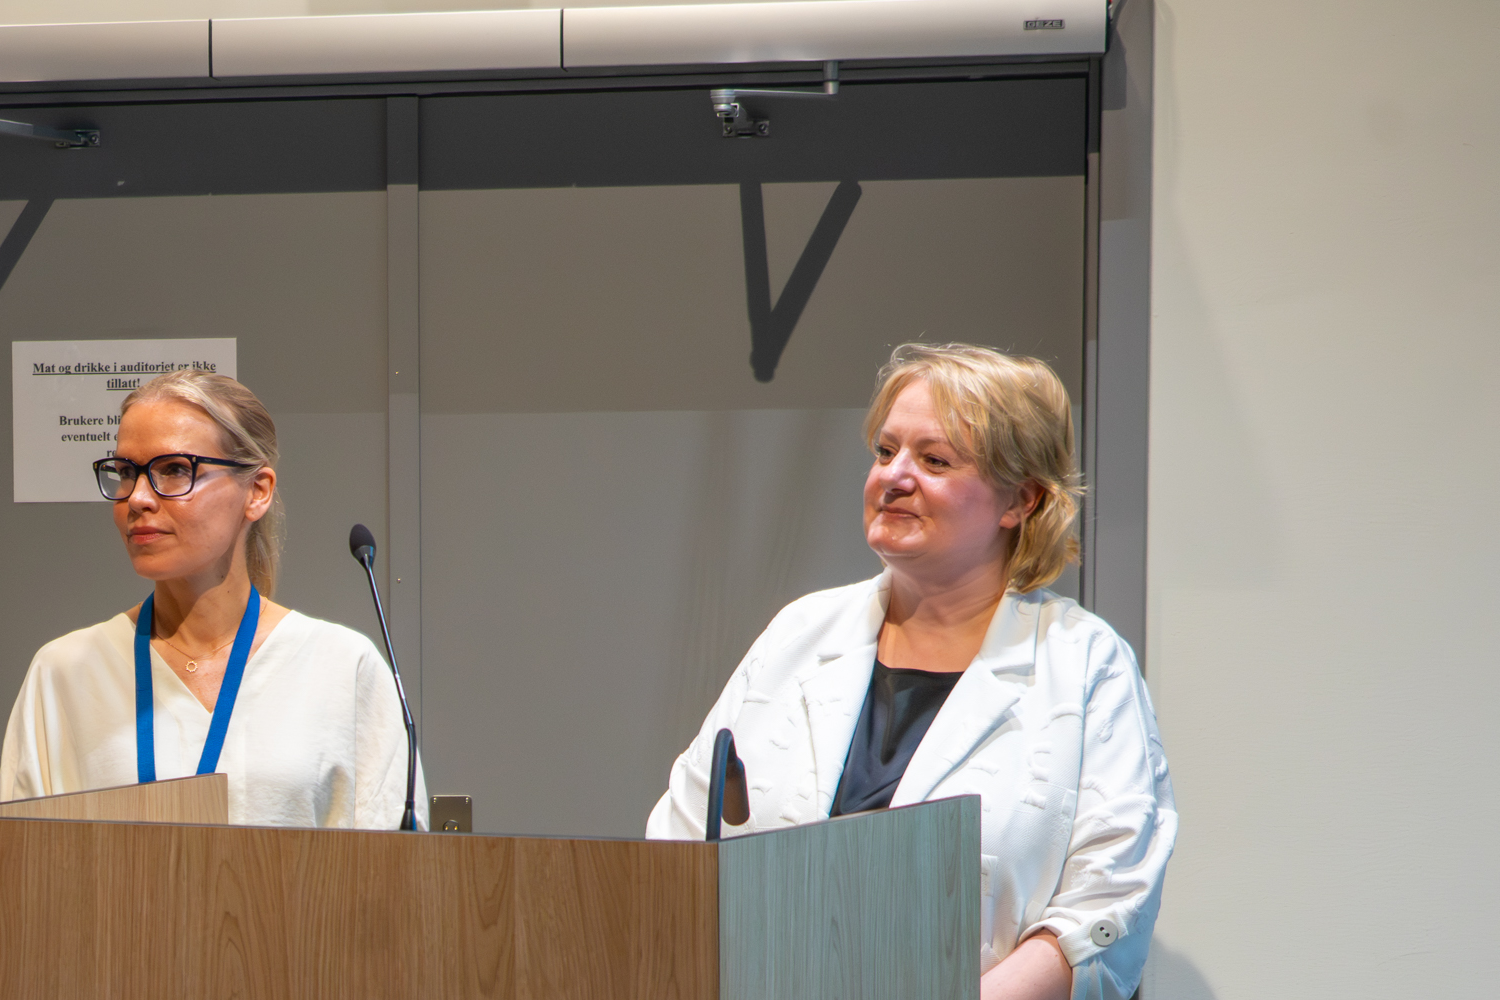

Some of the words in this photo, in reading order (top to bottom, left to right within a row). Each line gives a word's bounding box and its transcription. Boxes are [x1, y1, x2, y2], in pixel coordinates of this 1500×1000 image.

[33, 363, 56, 374] Mat
[58, 365, 72, 374] og
[74, 362, 111, 374] drikke
[120, 361, 175, 373] auditoriet
[177, 363, 190, 371] er
[192, 361, 217, 372] ikke
[106, 378, 141, 389] tillatt!
[59, 415, 104, 426] Brukere
[61, 431, 111, 442] eventuelt
